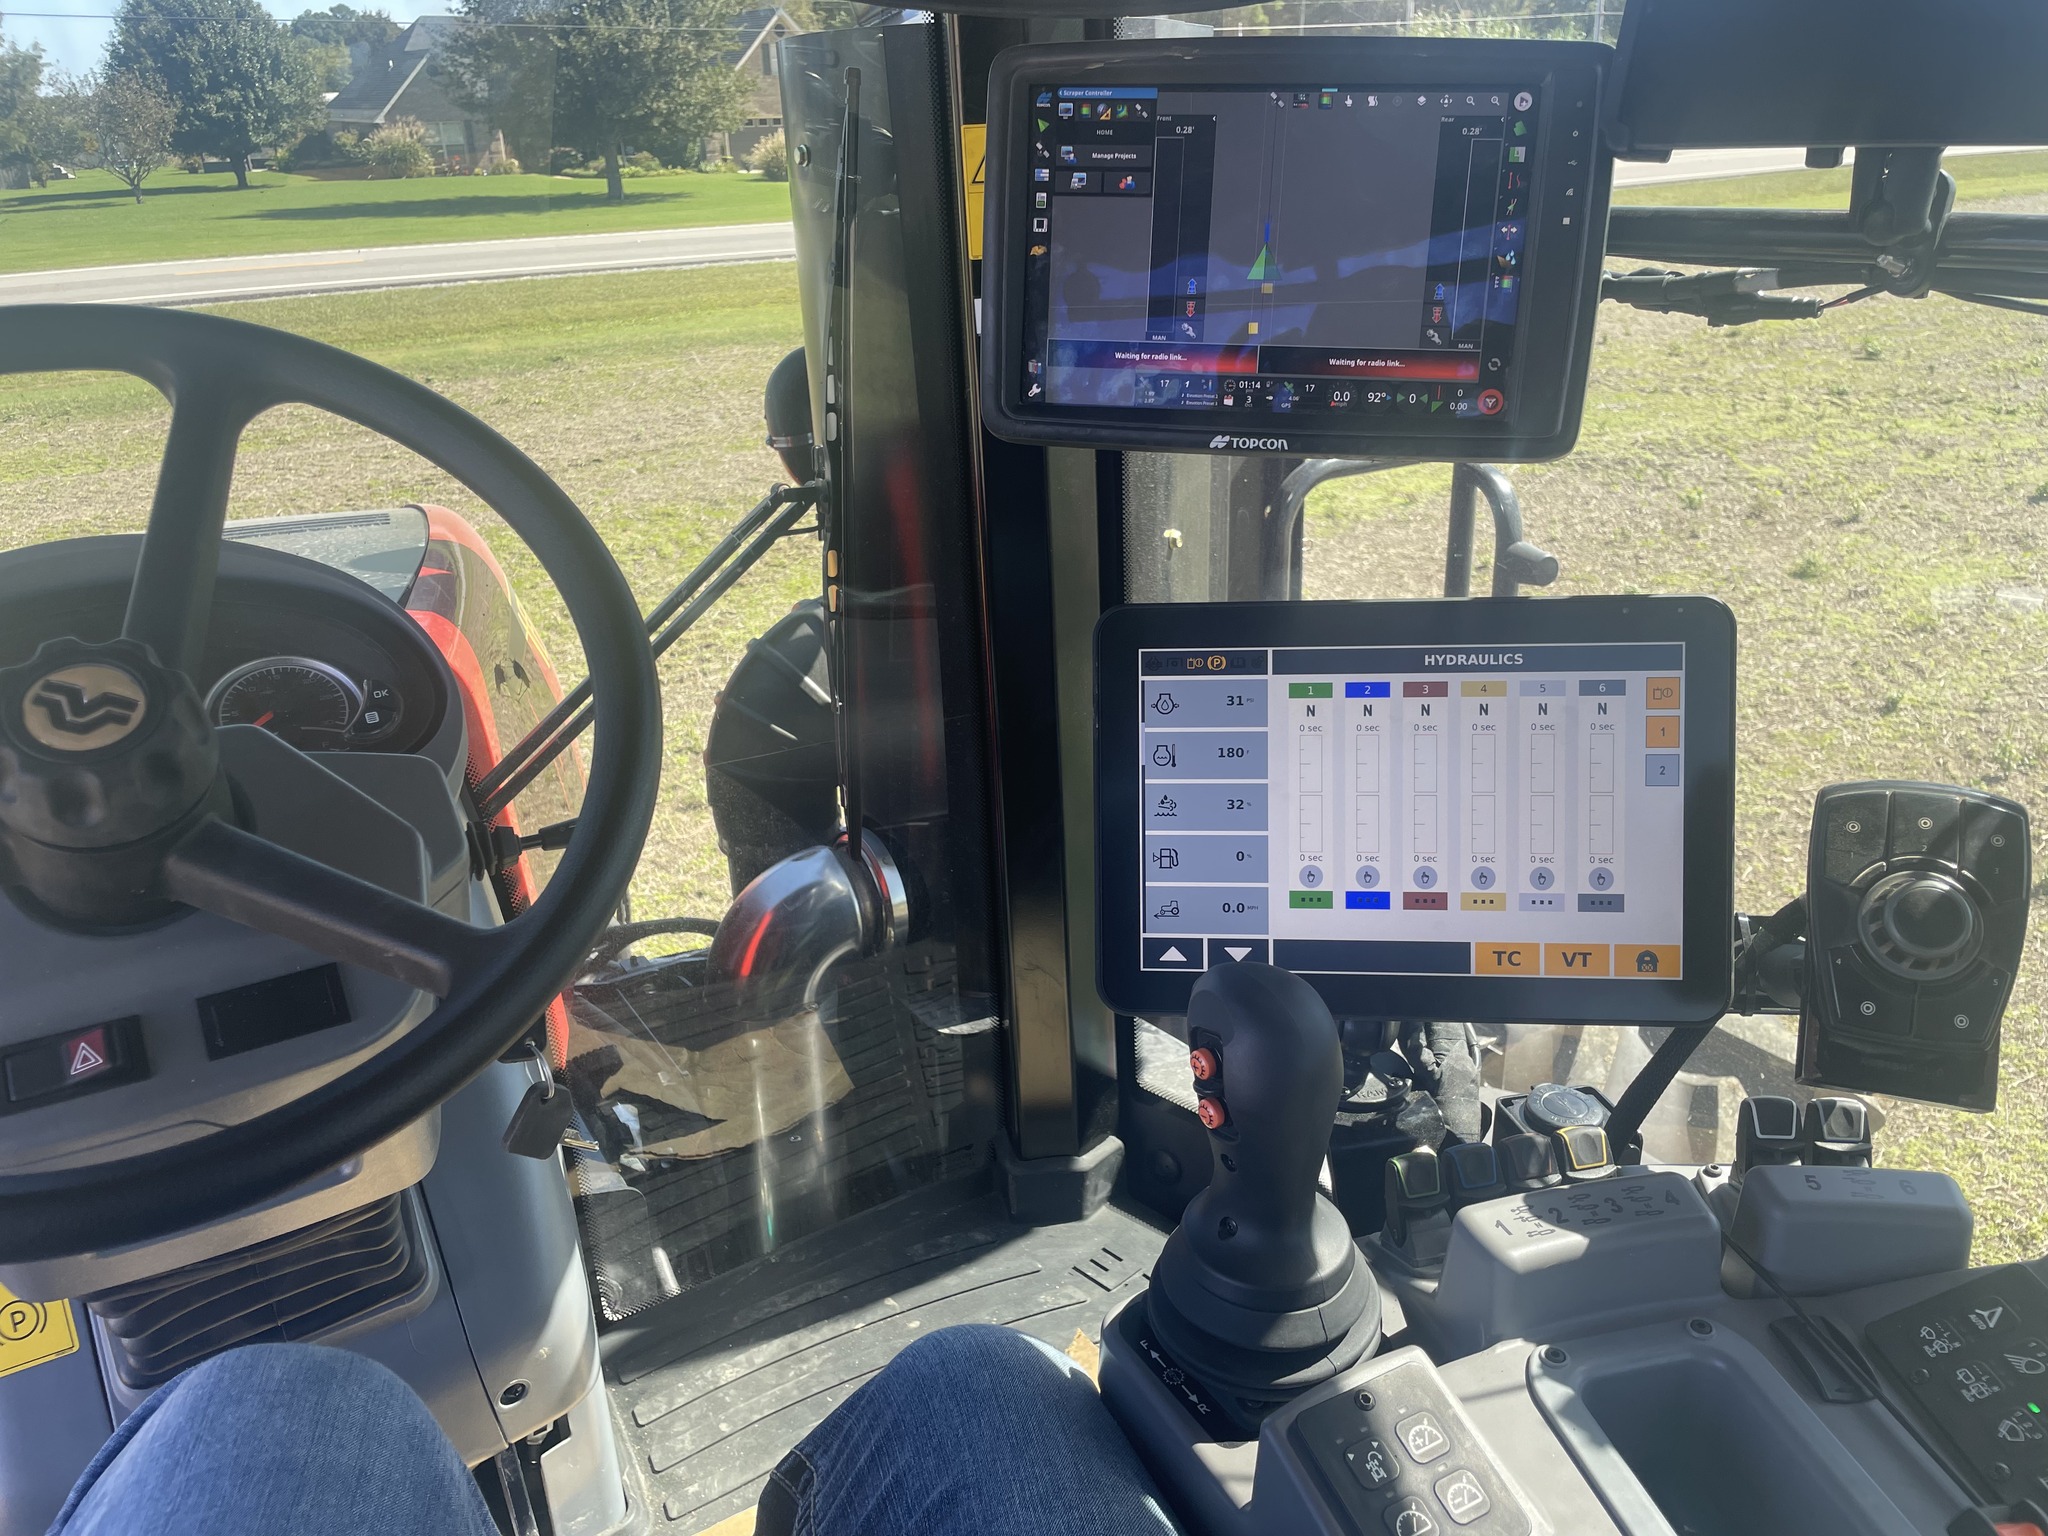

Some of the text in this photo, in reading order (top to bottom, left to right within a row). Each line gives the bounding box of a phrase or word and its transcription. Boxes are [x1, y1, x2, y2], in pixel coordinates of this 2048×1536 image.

[1063, 89, 1084, 97] Scraper
[1175, 126, 1195, 134] 0.28'
[1462, 127, 1483, 136] 0.28'
[1092, 152, 1137, 160] Manage Projects
[1115, 351, 1140, 361] Waiting
[1140, 352, 1151, 360] for
[1152, 353, 1169, 361] radio
[1329, 358, 1355, 368] Waiting
[1356, 359, 1367, 367] for
[1367, 359, 1386, 367] radio
[1160, 379, 1170, 388] 17
[1238, 380, 1261, 389] 01:14
[1305, 384, 1316, 392] 17
[1333, 391, 1351, 402] 0.0
[1367, 392, 1387, 403] 92°
[1457, 389, 1464, 397] 0
[1409, 393, 1417, 404] 0
[1450, 402, 1467, 411] 0.00
[1424, 653, 1524, 666] HYDRAULICS
[1308, 686, 1314, 695] 1
[1364, 686, 1371, 694] 2
[1422, 685, 1429, 694] 3
[1480, 684, 1487, 693] 4
[1540, 684, 1546, 693] 5
[1599, 684, 1606, 692] 6
[373, 689, 389, 699] OK
[1226, 695, 1244, 706] 31
[1306, 705, 1315, 717] N
[1363, 705, 1372, 716] N
[1421, 704, 1430, 716] N
[1480, 704, 1488, 715] N
[1538, 703, 1547, 715] N
[1598, 703, 1607, 715] N
[1299, 724, 1305, 732] 0
[1356, 724, 1362, 732] 0
[1414, 724, 1419, 732] 0
[1472, 723, 1477, 731] 0
[1531, 723, 1536, 731] 0
[1661, 727, 1666, 736] 1
[1218, 747, 1244, 758] 180
[1659, 766, 1666, 775] 2
[1227, 799, 1244, 810] 32
[1236, 851, 1245, 862] 0
[1300, 854, 1305, 862] 0
[1356, 854, 1362, 862] 0
[1414, 855, 1419, 863] 0
[1472, 855, 1477, 863] 0
[1530, 856, 1536, 864] 0
[1589, 856, 1595, 864] 0
[1223, 903, 1245, 913] 0.0
[1493, 950, 1521, 967] TC
[1561, 952, 1592, 968] VT
[1804, 1175, 1821, 1190] 5
[1898, 1180, 1917, 1195] 6
[1665, 1190, 1681, 1206] 4
[1604, 1197, 1623, 1213] 3
[1548, 1208, 1570, 1224] 2
[1494, 1219, 1513, 1236] 1
[10, 1310, 26, 1333] P
[1968, 1314, 1987, 1330] AUTO
[1140, 1340, 1148, 1350] F
[1197, 1404, 1211, 1414] R
